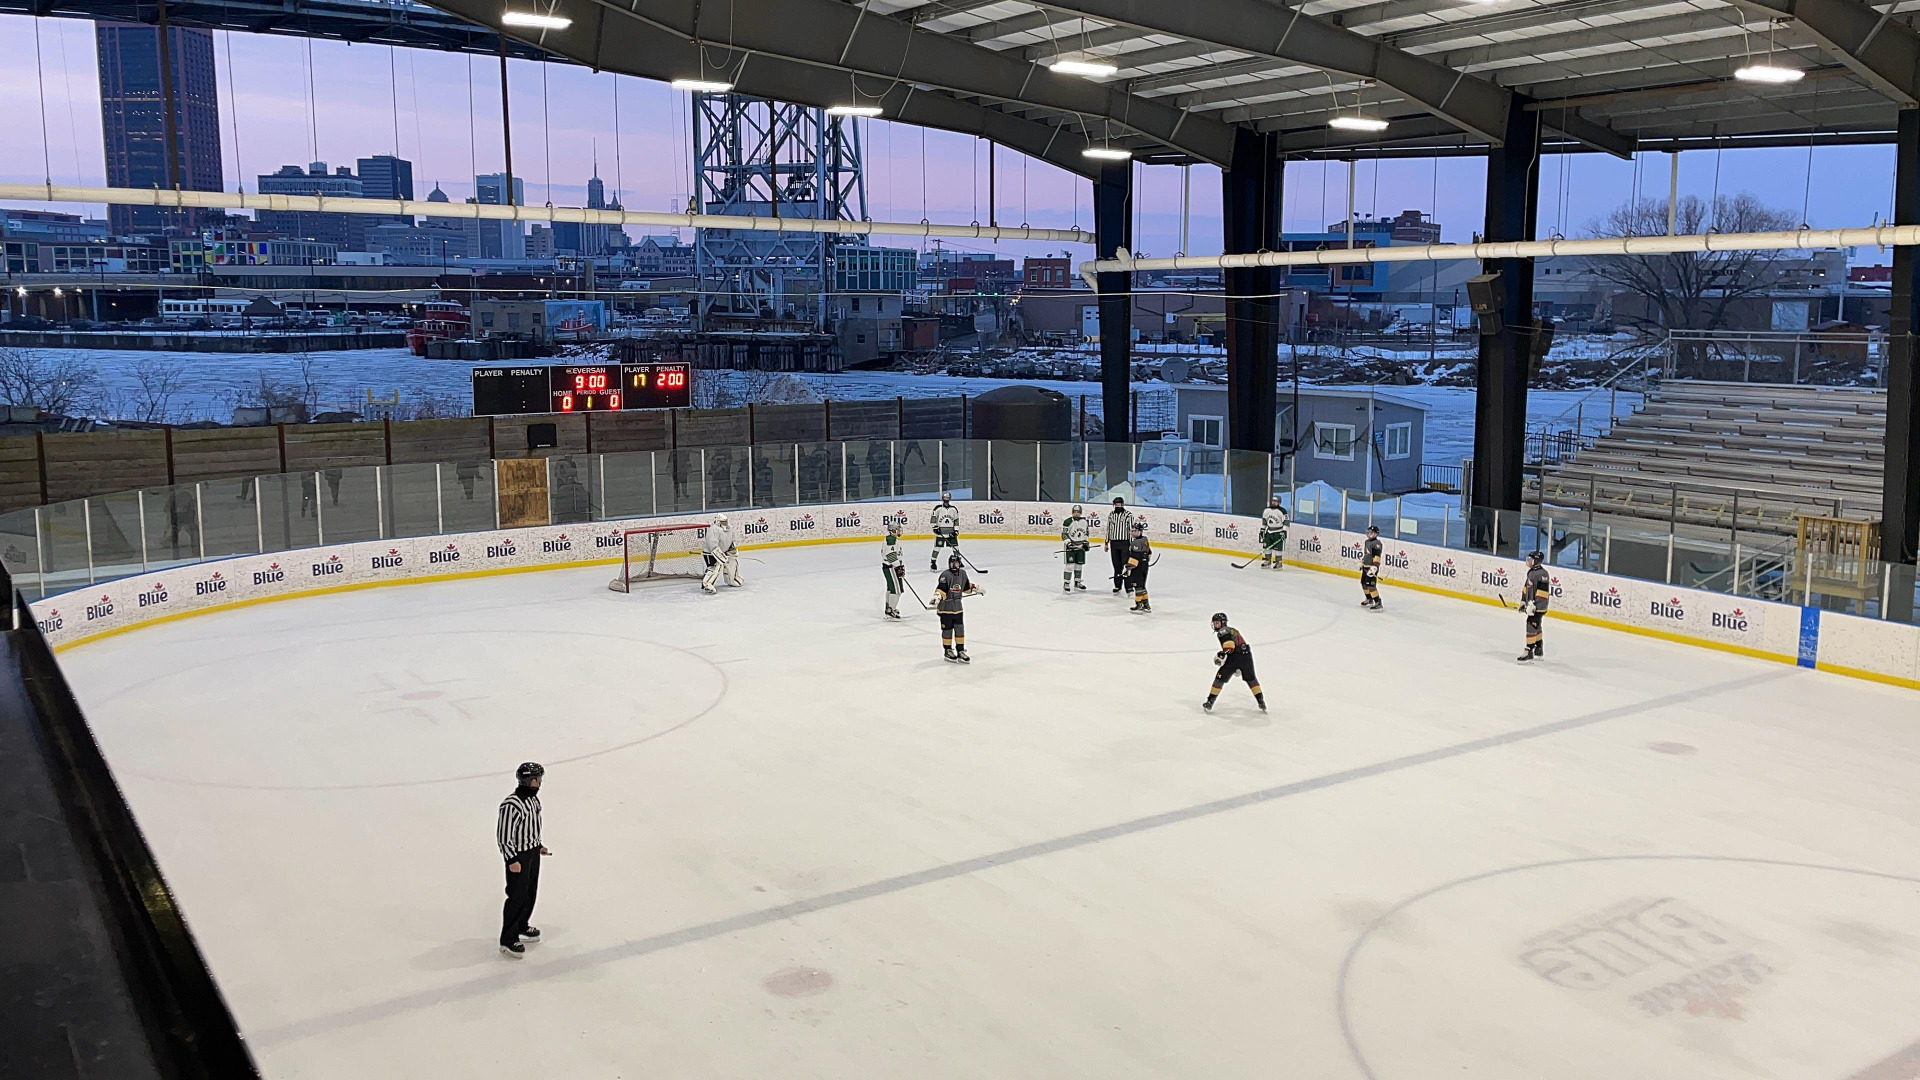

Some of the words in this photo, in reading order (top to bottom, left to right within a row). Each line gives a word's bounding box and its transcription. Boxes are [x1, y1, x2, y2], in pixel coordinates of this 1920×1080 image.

[474, 369, 503, 377] PLAYER
[510, 368, 543, 376] PENALTY
[656, 365, 685, 373] PENALTY
[633, 373, 646, 388] 17
[562, 396, 572, 410] 0
[587, 395, 593, 409] 1
[610, 394, 619, 408] 0
[790, 519, 815, 531] Blue
[835, 517, 861, 528] Blue
[978, 513, 1005, 525] Blue
[1028, 514, 1054, 526] Blue
[744, 523, 769, 535] Blue
[1169, 522, 1194, 535] Blue
[1215, 527, 1239, 540] Blue
[542, 538, 572, 553] Blue
[595, 535, 624, 549] Blue
[1299, 538, 1322, 553] Blue
[429, 549, 460, 564] Blue
[486, 544, 516, 559] Blue
[1341, 545, 1364, 560] Blue
[371, 554, 403, 569] Blue
[1385, 553, 1409, 569] Blue
[312, 562, 344, 577] Blue
[1430, 562, 1456, 578] Blue
[253, 571, 285, 586] Blue
[1481, 571, 1508, 588] Blue
[195, 579, 226, 596] Blue
[138, 590, 168, 608] Blue
[1590, 591, 1621, 609] Blue
[86, 603, 114, 621] Blue
[1650, 601, 1684, 620] Blue
[1712, 612, 1748, 632] Blue
